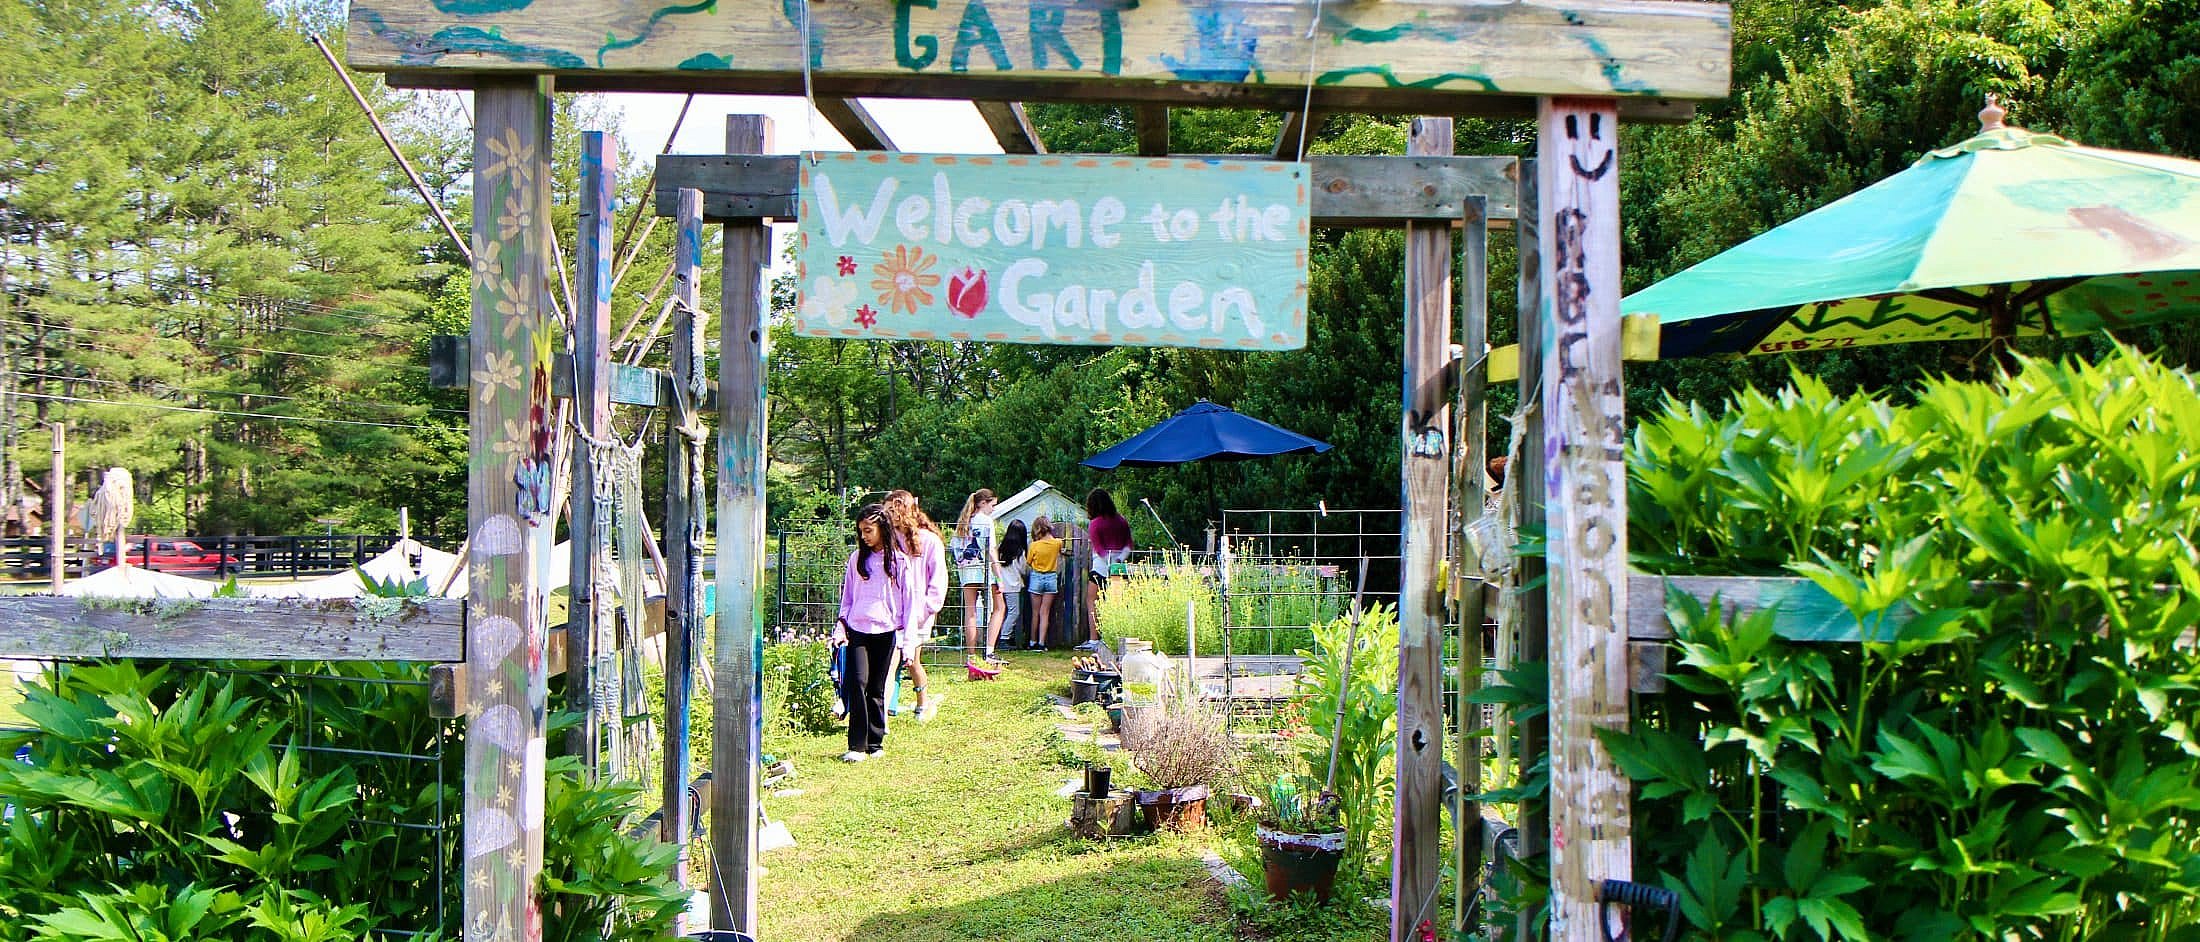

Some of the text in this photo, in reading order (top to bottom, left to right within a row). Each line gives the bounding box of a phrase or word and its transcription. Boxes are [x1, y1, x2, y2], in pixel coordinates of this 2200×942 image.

[814, 171, 1292, 249] Welcome to the
[999, 257, 1264, 339] Garden
